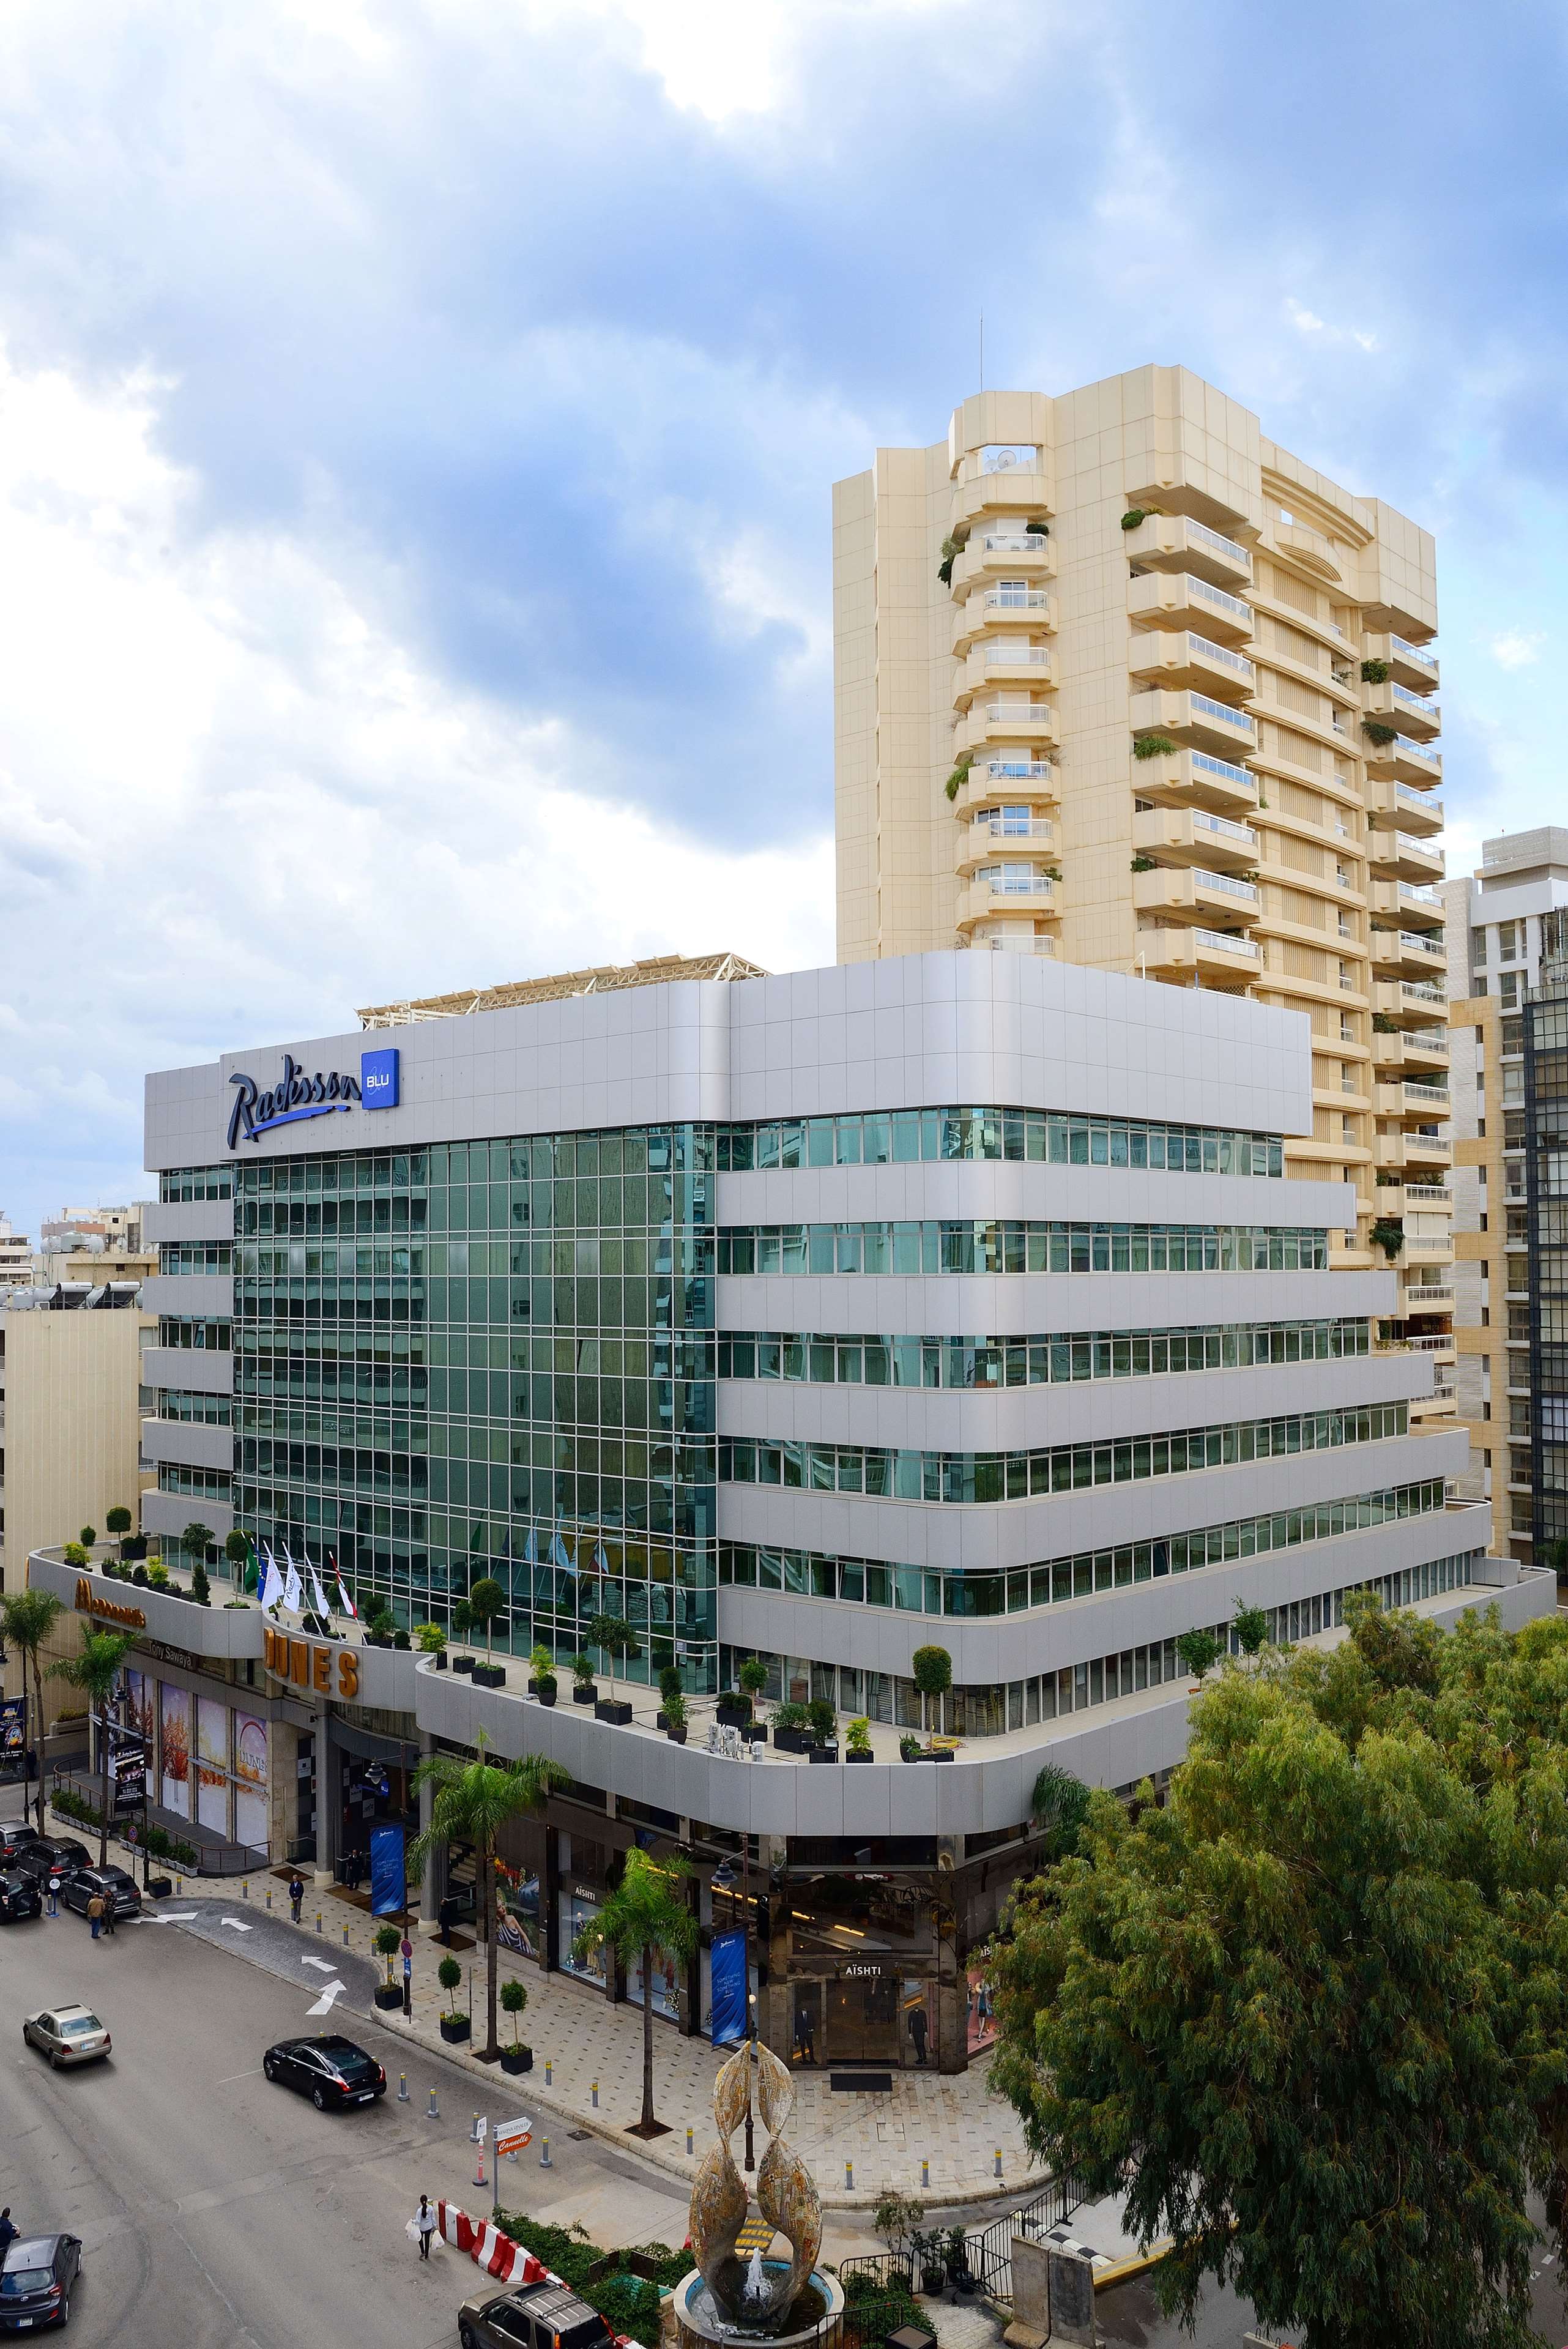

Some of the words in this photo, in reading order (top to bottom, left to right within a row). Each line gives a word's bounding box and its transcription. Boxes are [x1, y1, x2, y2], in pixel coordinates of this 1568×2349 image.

[227, 1054, 362, 1150] Radisson
[367, 1074, 389, 1087] BLU
[149, 1640, 164, 1659] Tony
[165, 1647, 191, 1668] Sawaya
[264, 1626, 358, 1697] DUNES
[845, 1964, 881, 1975] AÏSHTI
[499, 2135, 529, 2151] Cannelle
